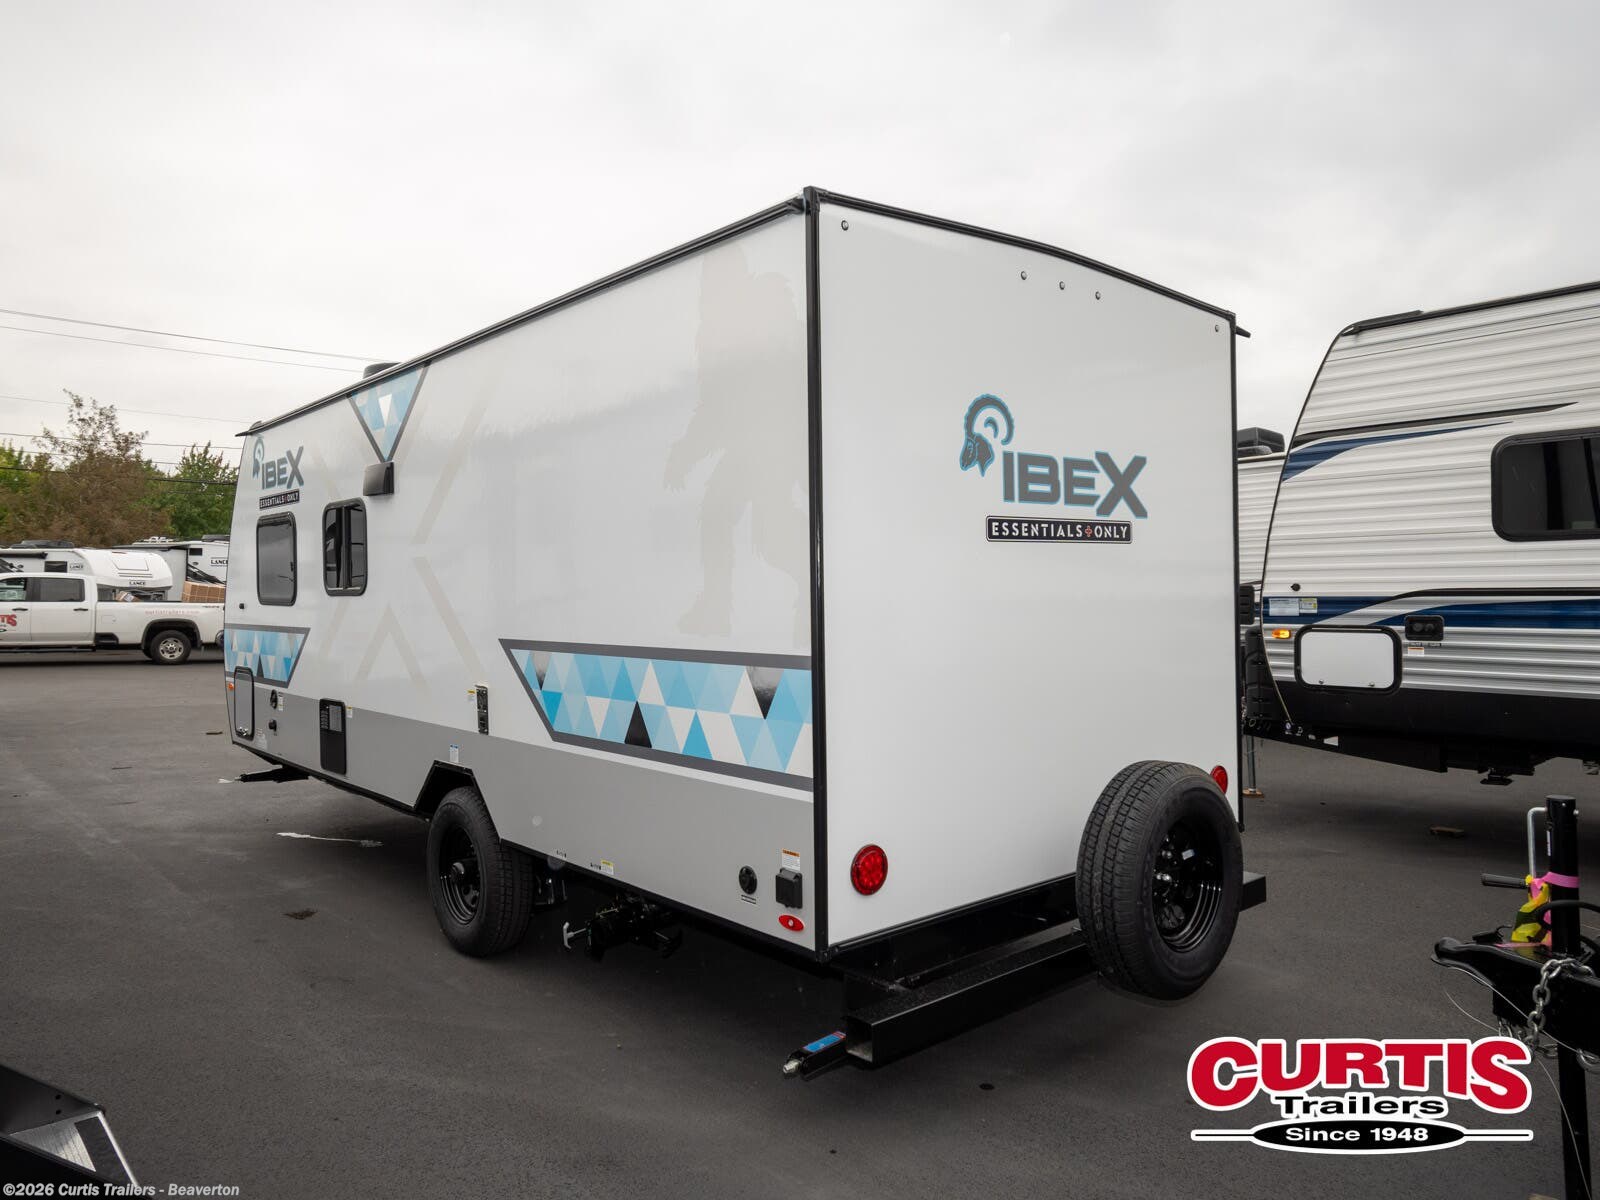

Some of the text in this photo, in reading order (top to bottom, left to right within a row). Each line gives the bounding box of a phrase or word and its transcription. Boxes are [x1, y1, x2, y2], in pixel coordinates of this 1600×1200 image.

[262, 446, 304, 489] IBEX
[1002, 451, 1148, 519] IBEX
[991, 522, 1128, 539] ESSENTIALS ONLY
